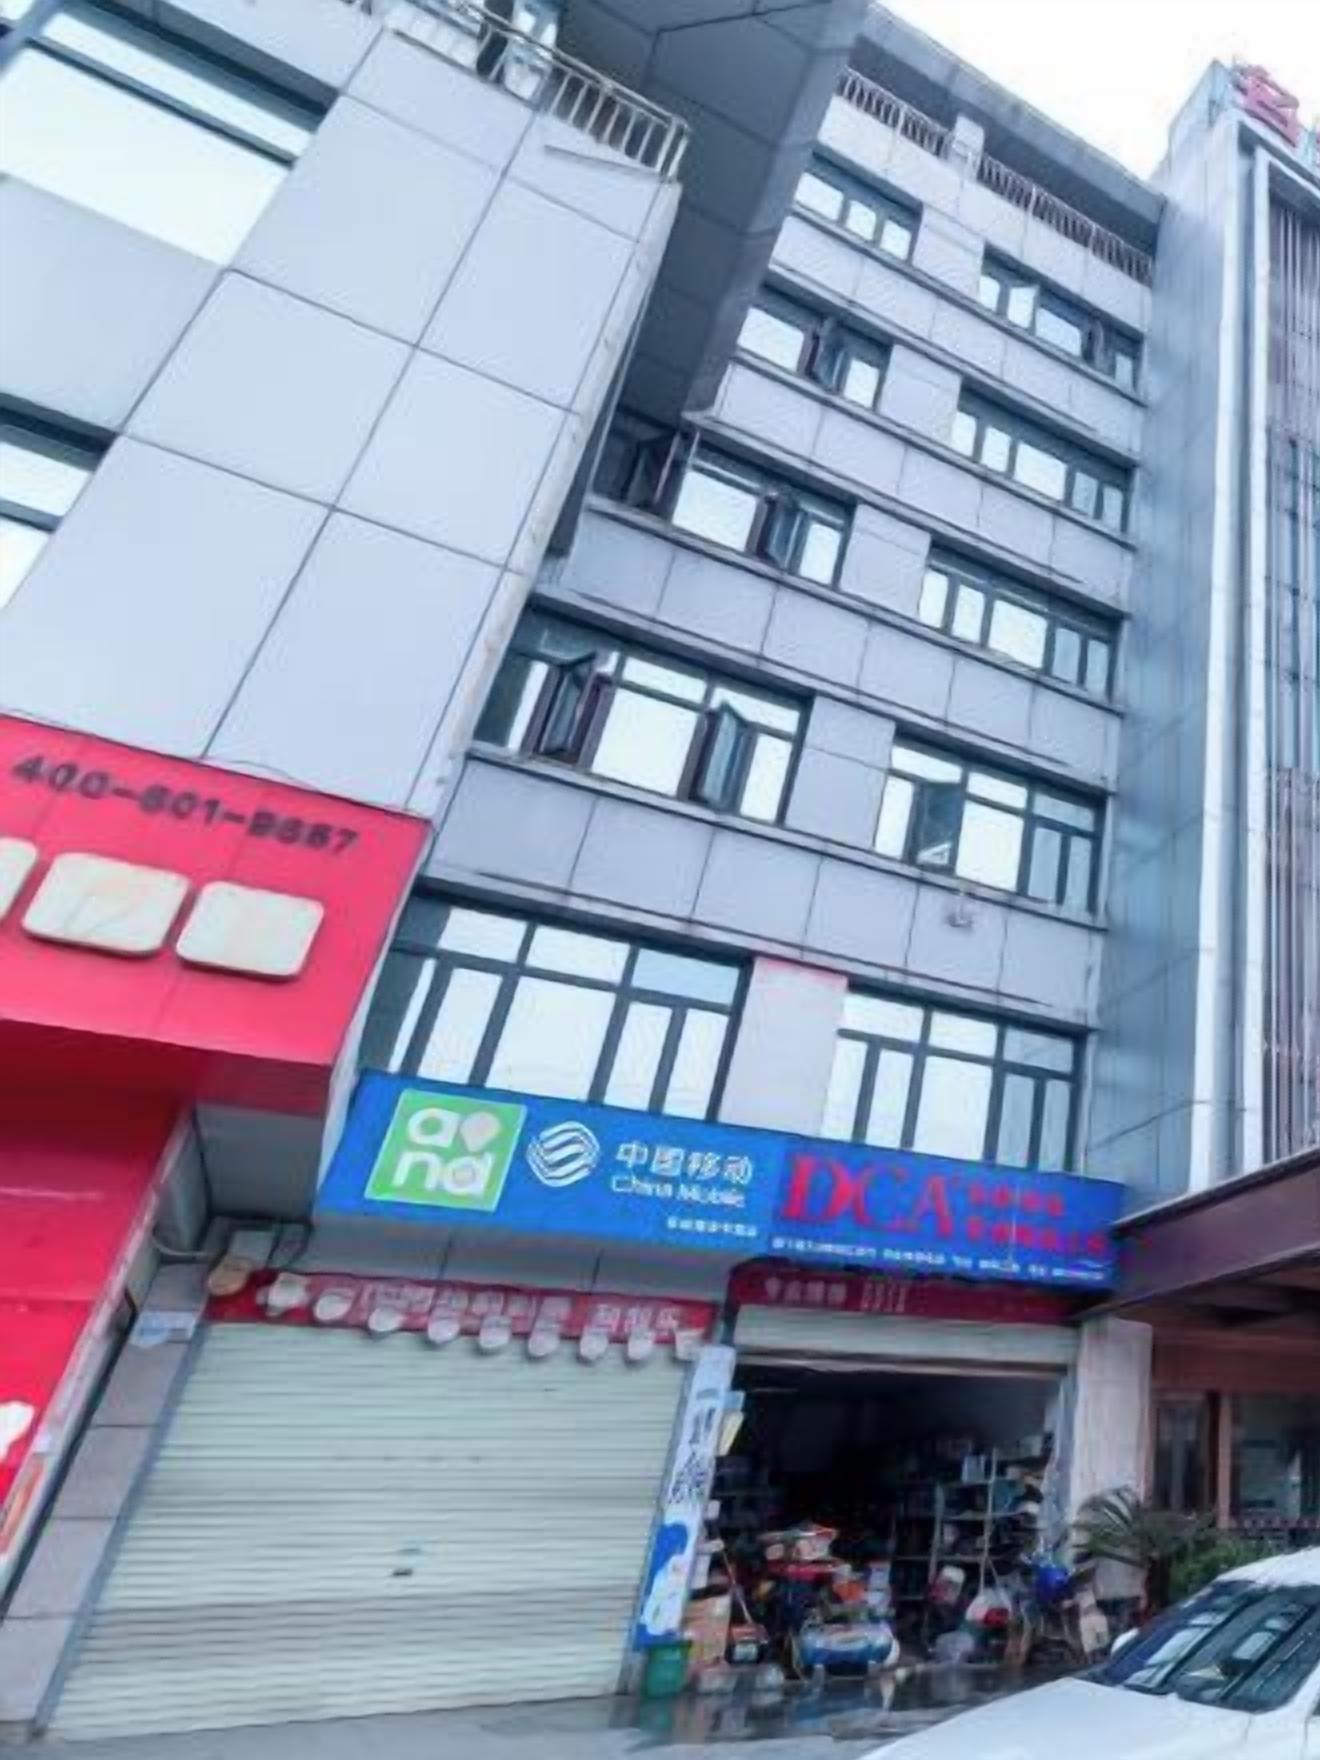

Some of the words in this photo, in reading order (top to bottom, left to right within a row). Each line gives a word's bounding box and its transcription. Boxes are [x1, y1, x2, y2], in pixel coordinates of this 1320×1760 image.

[615, 1140, 754, 1186] 中国移动
[780, 1152, 957, 1240] DCA
